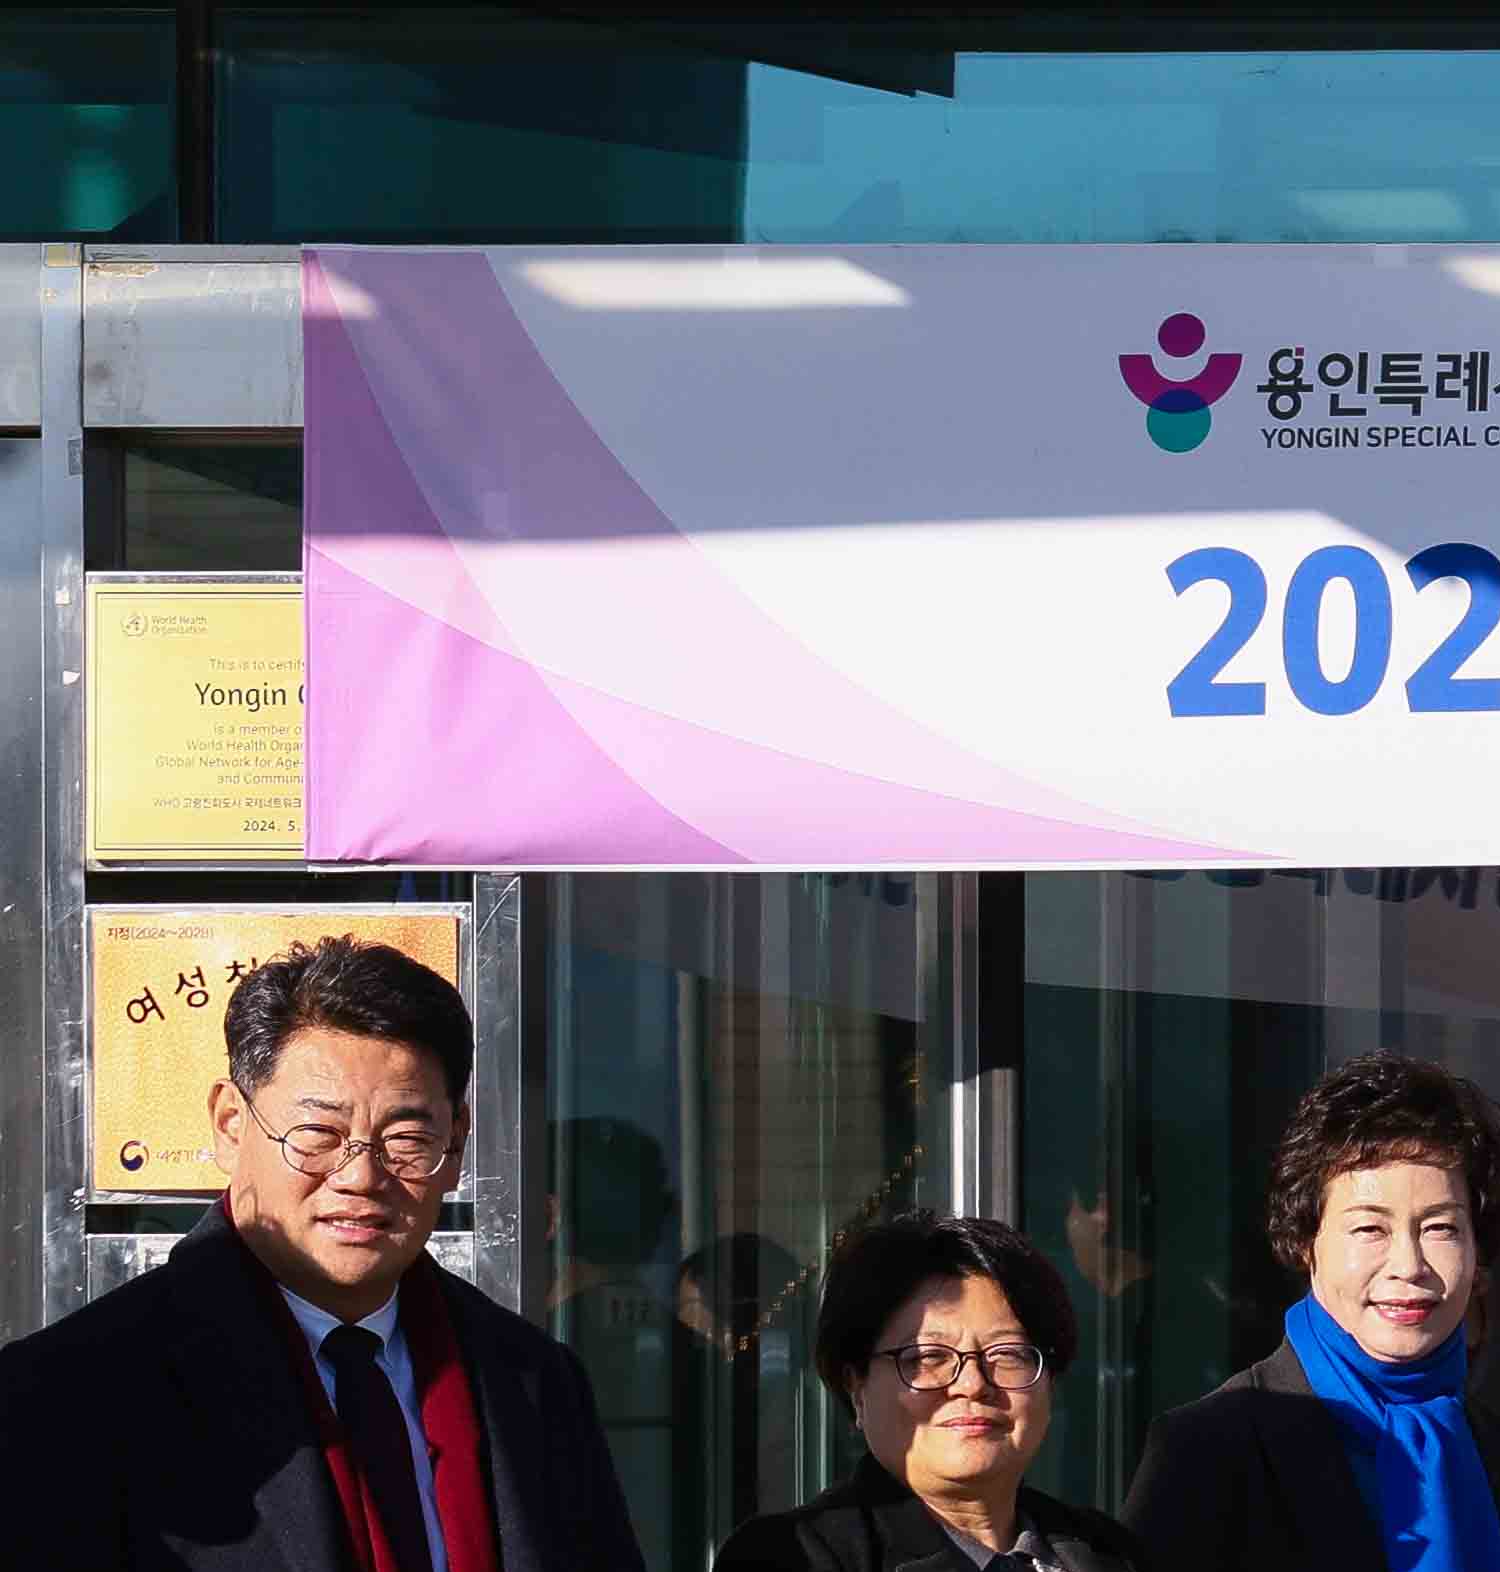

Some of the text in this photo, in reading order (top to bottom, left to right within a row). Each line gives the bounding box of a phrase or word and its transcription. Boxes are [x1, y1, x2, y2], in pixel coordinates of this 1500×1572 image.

[1261, 427, 1360, 449] YONGIN
[1366, 426, 1477, 448] SPECIAL
[209, 658, 235, 672] This
[239, 658, 249, 671] is
[253, 659, 266, 672] to
[195, 682, 287, 713] Yongin
[213, 724, 224, 736] is
[239, 724, 290, 736] member
[186, 740, 223, 752] World
[226, 740, 267, 752] Health
[155, 757, 195, 769] Global
[199, 757, 249, 769] Network
[255, 757, 271, 769] for
[217, 774, 240, 786] and
[243, 819, 281, 832] 2024.
